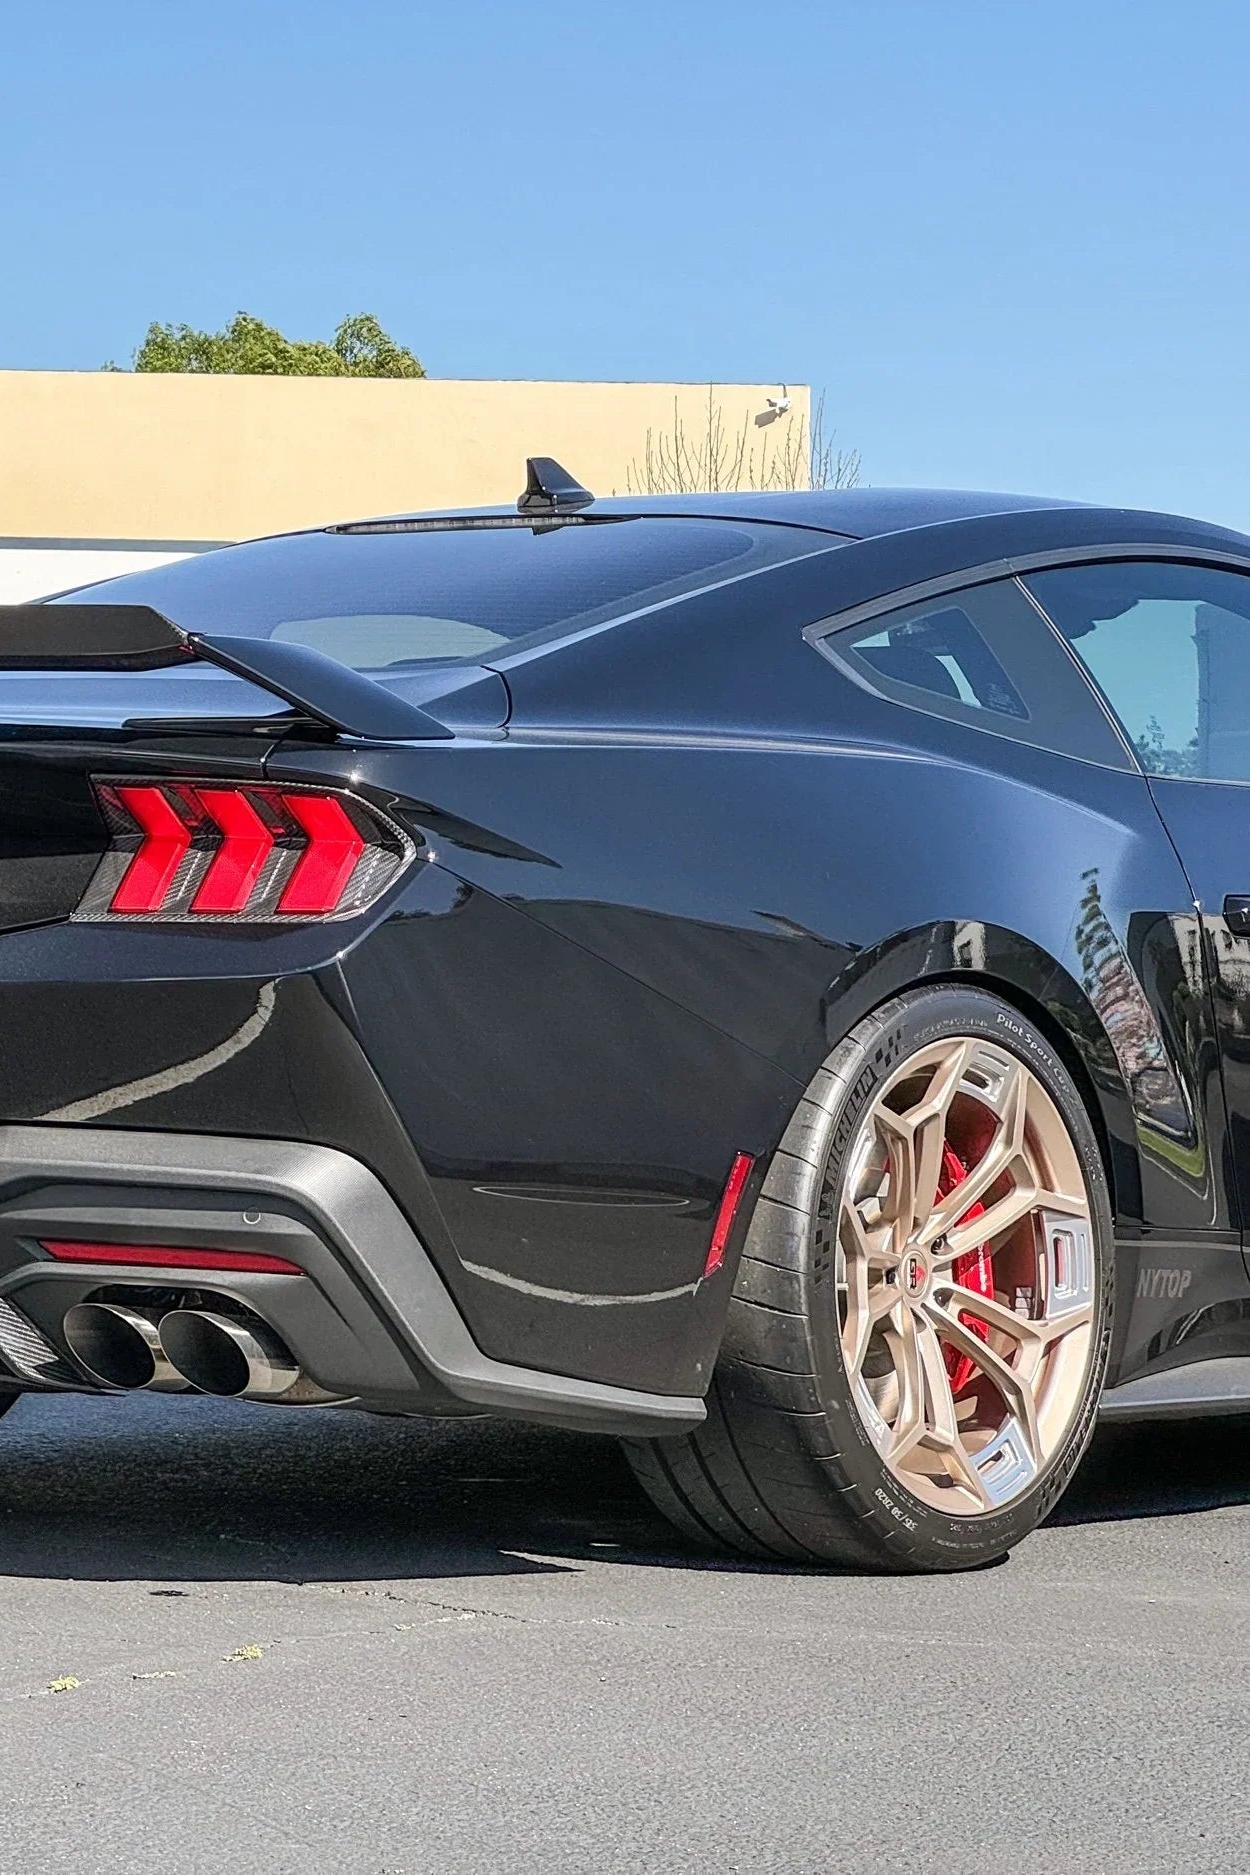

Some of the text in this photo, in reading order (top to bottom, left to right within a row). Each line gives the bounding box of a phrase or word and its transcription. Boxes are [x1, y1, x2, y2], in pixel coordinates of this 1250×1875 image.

[996, 1013, 1024, 1037] Pilot
[1024, 1033, 1053, 1066] Sport
[1053, 1066, 1070, 1094] Cup
[825, 1065, 878, 1192] MICHELIN
[874, 1488, 892, 1510] ZR20
